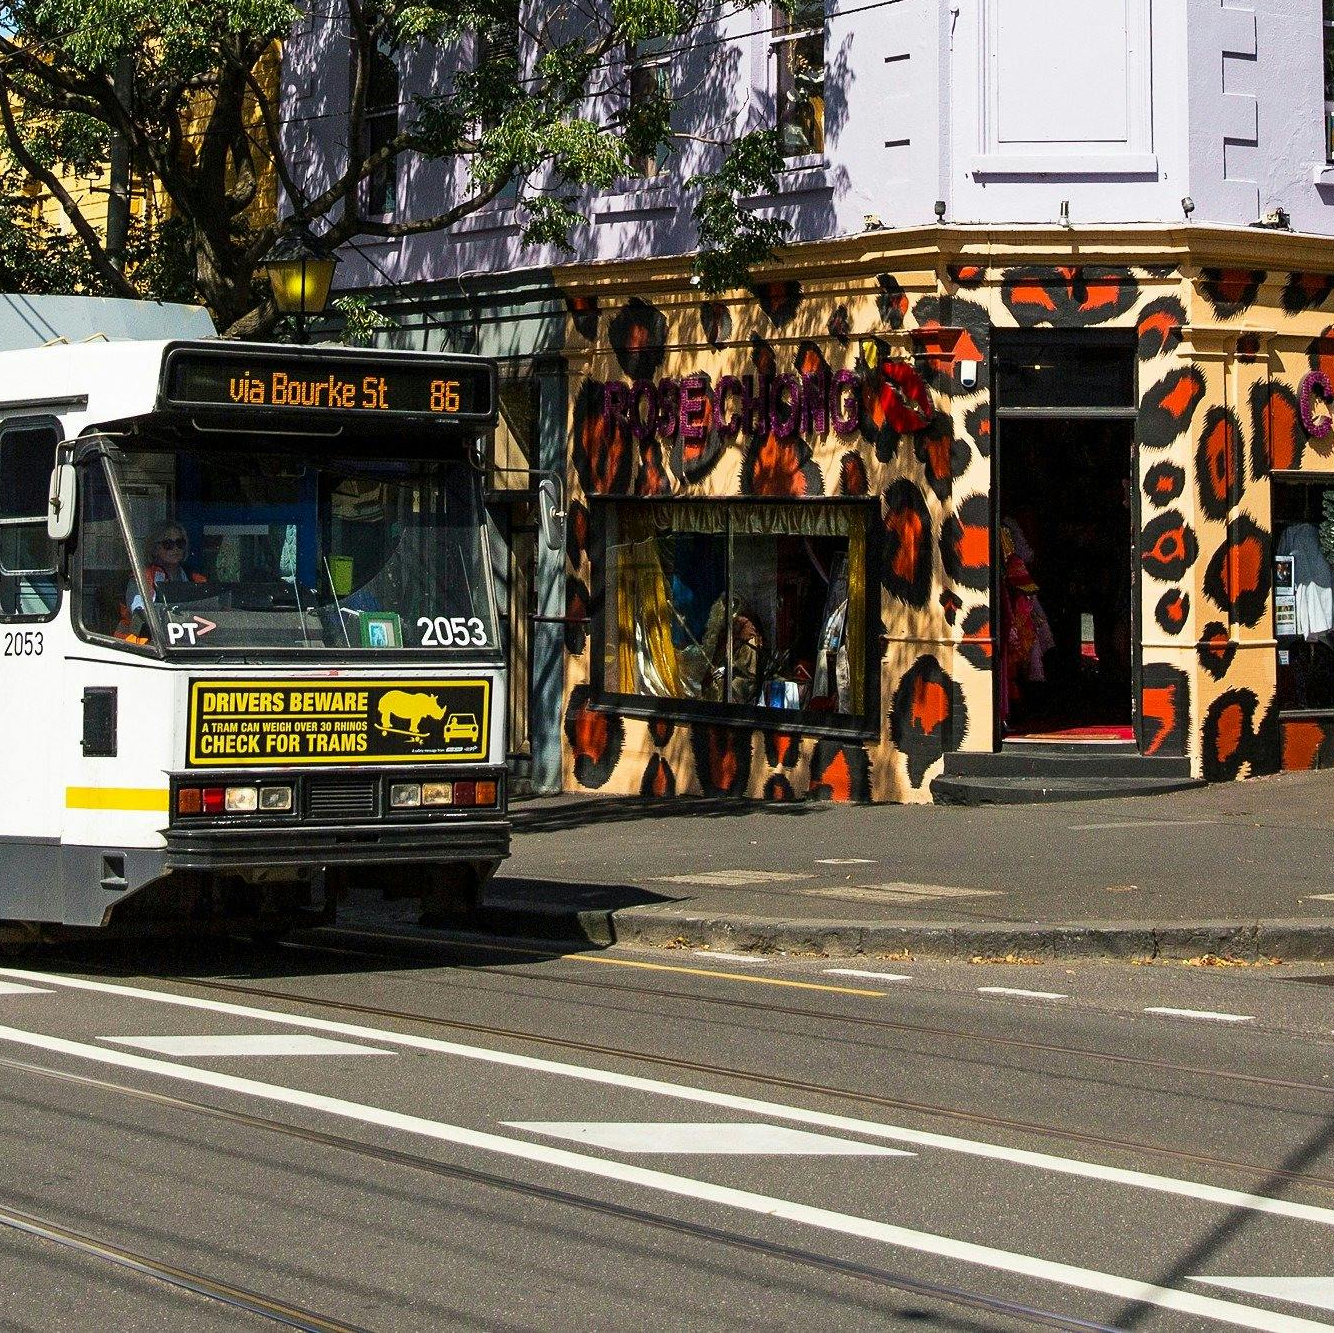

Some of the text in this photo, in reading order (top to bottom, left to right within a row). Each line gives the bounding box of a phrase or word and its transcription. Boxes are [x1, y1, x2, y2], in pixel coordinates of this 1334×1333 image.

[229, 370, 389, 410] via Bourke St
[429, 380, 461, 412] 86
[604, 368, 861, 440] ROSE CHONG
[4, 631, 44, 656] 2053
[416, 616, 487, 646] 2053
[203, 692, 369, 713] DRIVERS BEWARE
[202, 721, 368, 733] A TRAM CAN WEIGH OVER 30 RHINOS
[201, 733, 368, 754] CHECK FOR TRAMS
